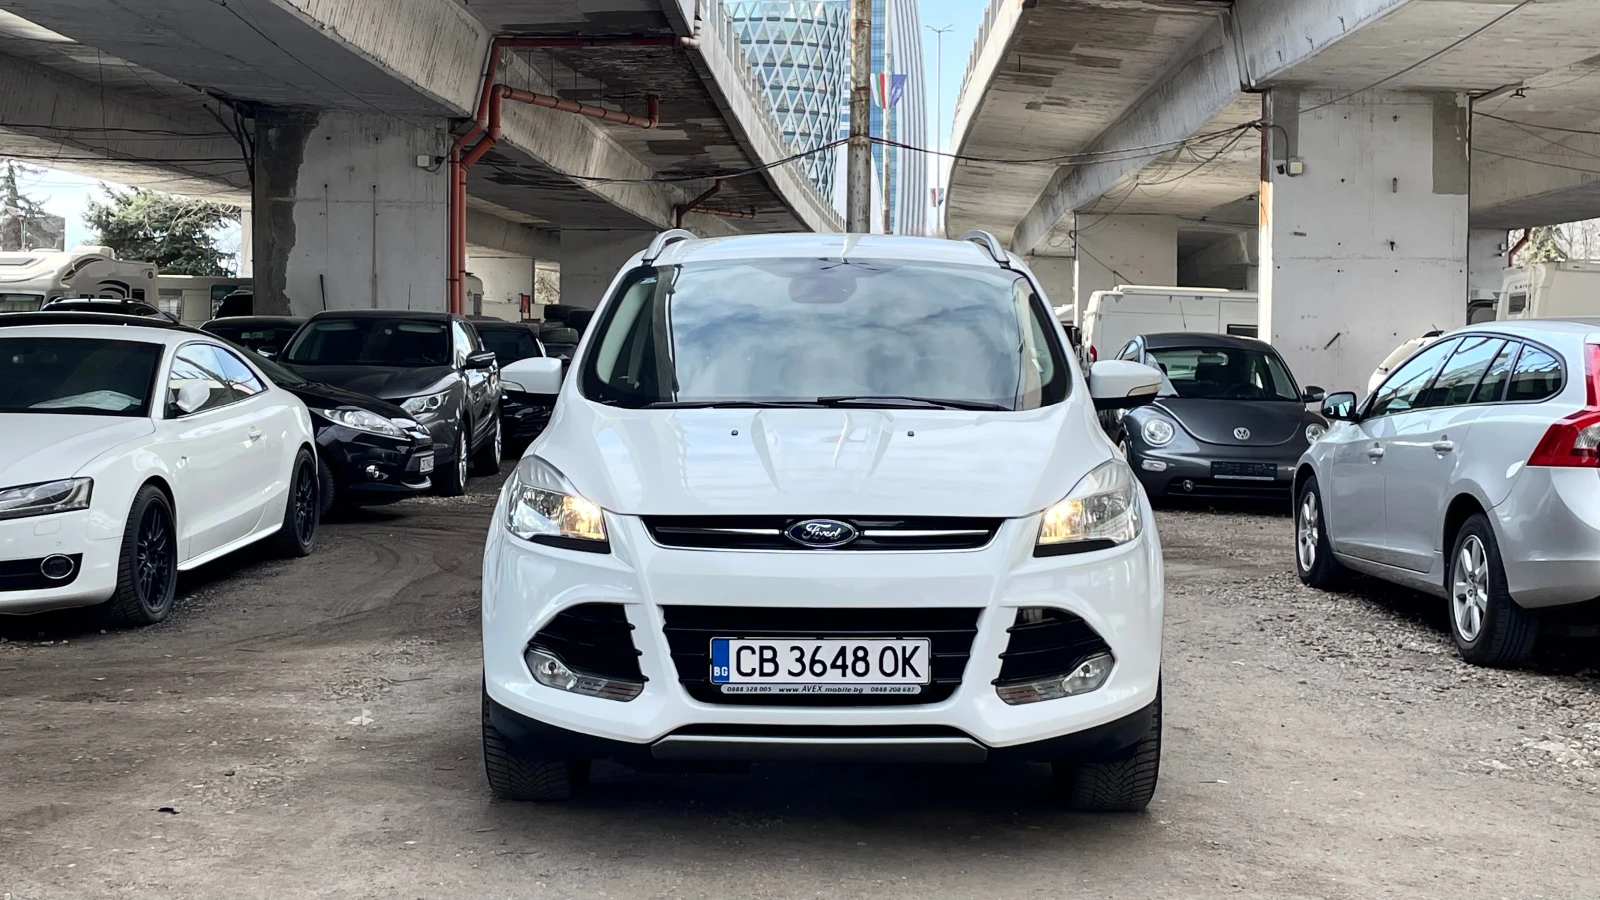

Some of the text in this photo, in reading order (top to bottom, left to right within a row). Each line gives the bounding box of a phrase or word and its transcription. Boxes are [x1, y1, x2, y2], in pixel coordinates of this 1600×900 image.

[802, 523, 841, 540] Ford
[736, 645, 922, 678] CB 3648 OK
[714, 666, 728, 677] BG
